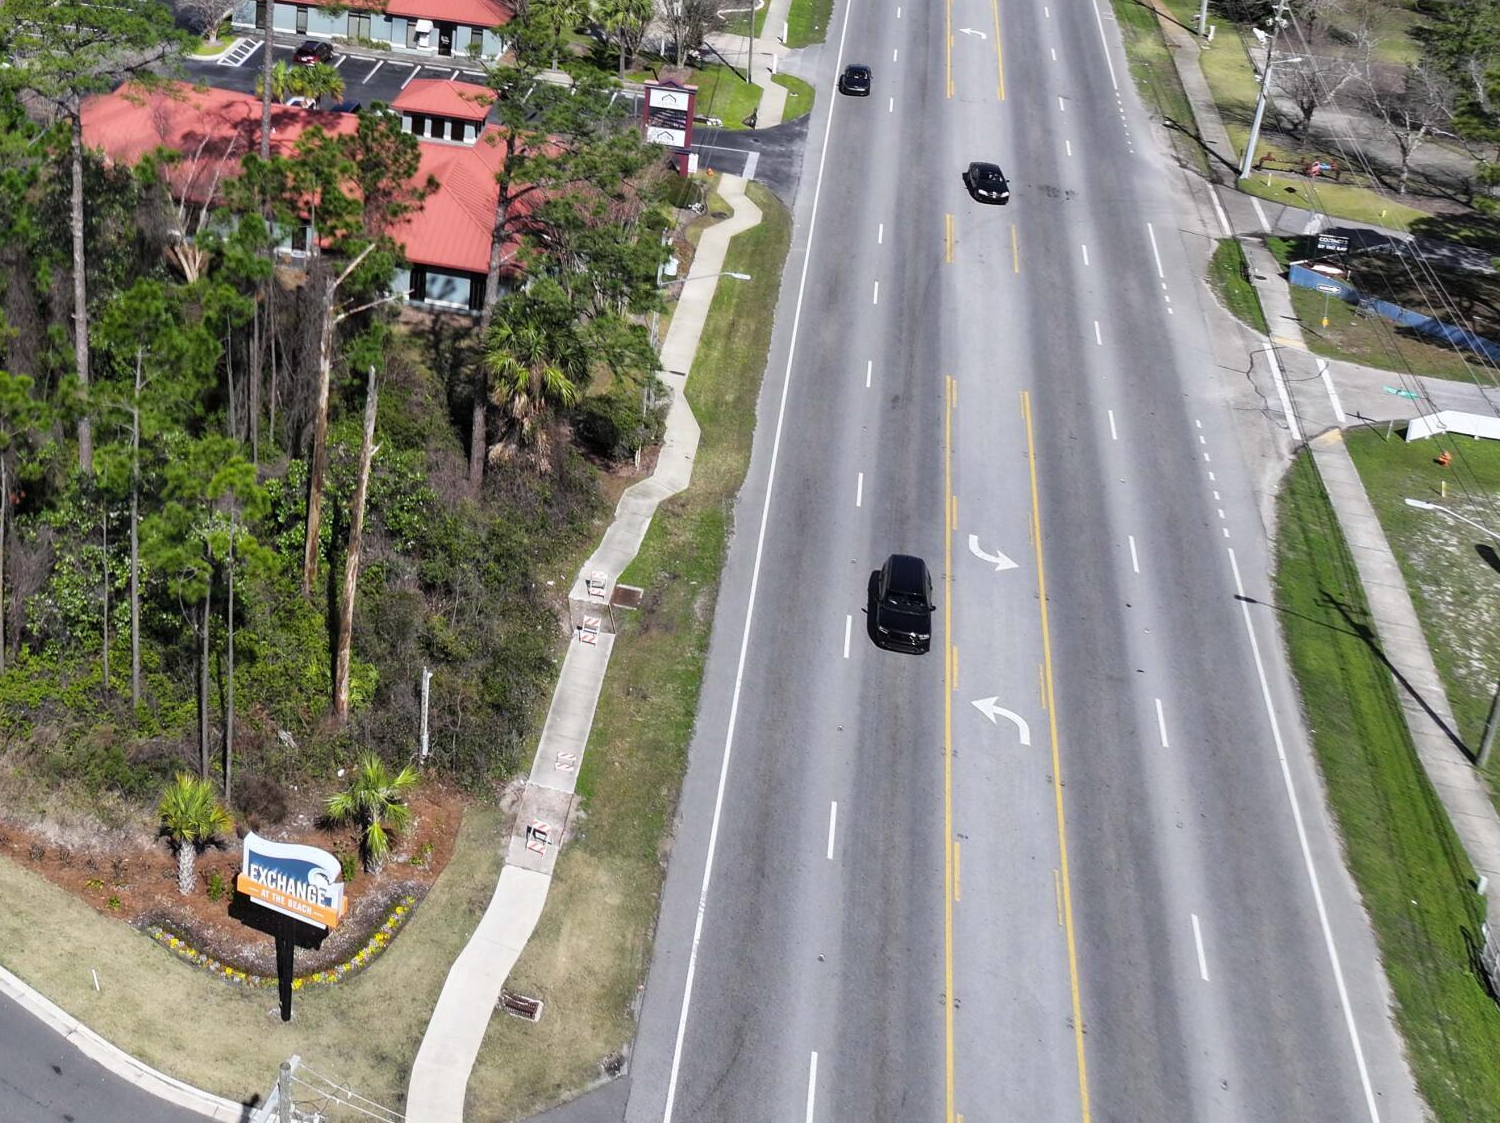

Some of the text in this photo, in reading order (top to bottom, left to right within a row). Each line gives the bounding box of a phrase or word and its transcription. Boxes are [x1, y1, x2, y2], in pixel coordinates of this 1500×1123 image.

[250, 863, 327, 908] EXCHANGE
[260, 889, 312, 915] AT THE BEACH
